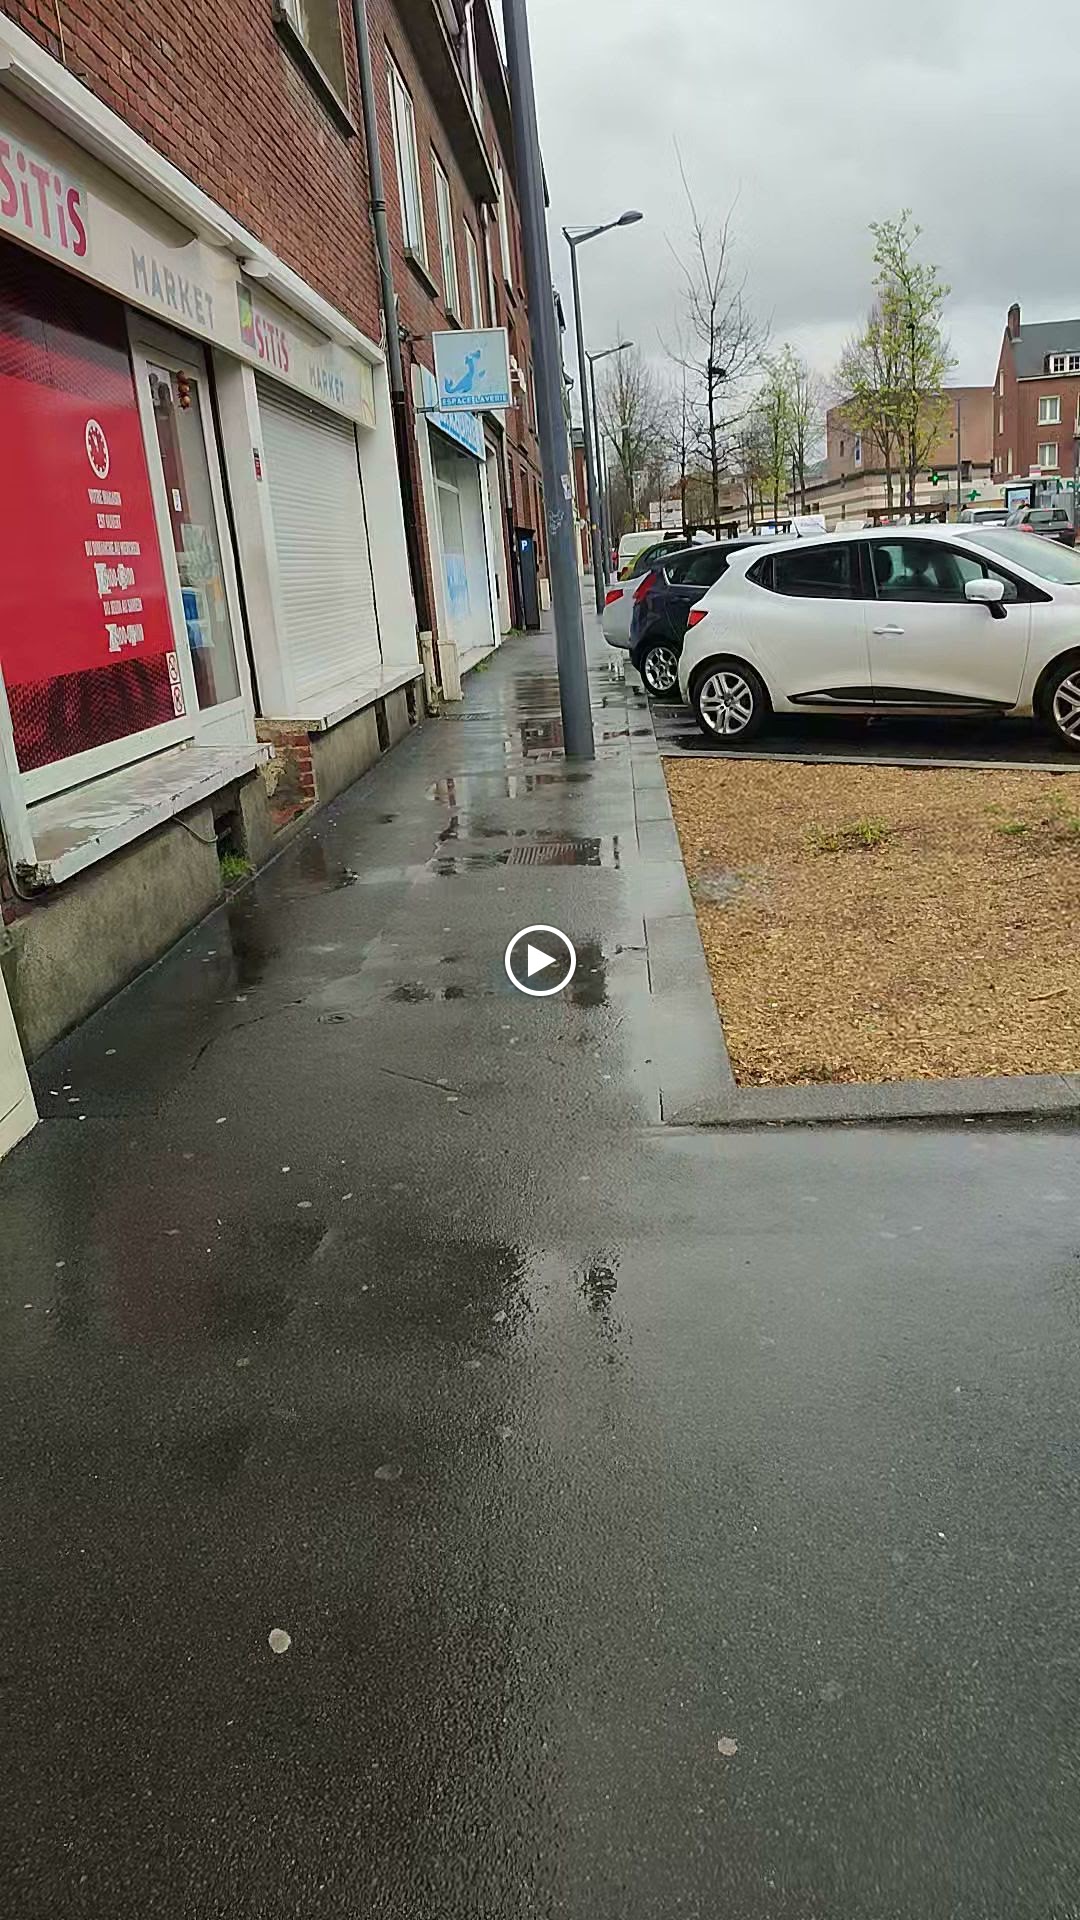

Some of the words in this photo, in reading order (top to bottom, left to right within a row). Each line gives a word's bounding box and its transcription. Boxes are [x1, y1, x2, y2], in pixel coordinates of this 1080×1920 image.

[131, 246, 213, 329] MARKET
[309, 365, 345, 405] MARKET
[441, 397, 472, 406] ESPACE
[474, 393, 507, 404] LAVERIE
[521, 540, 528, 551] P
